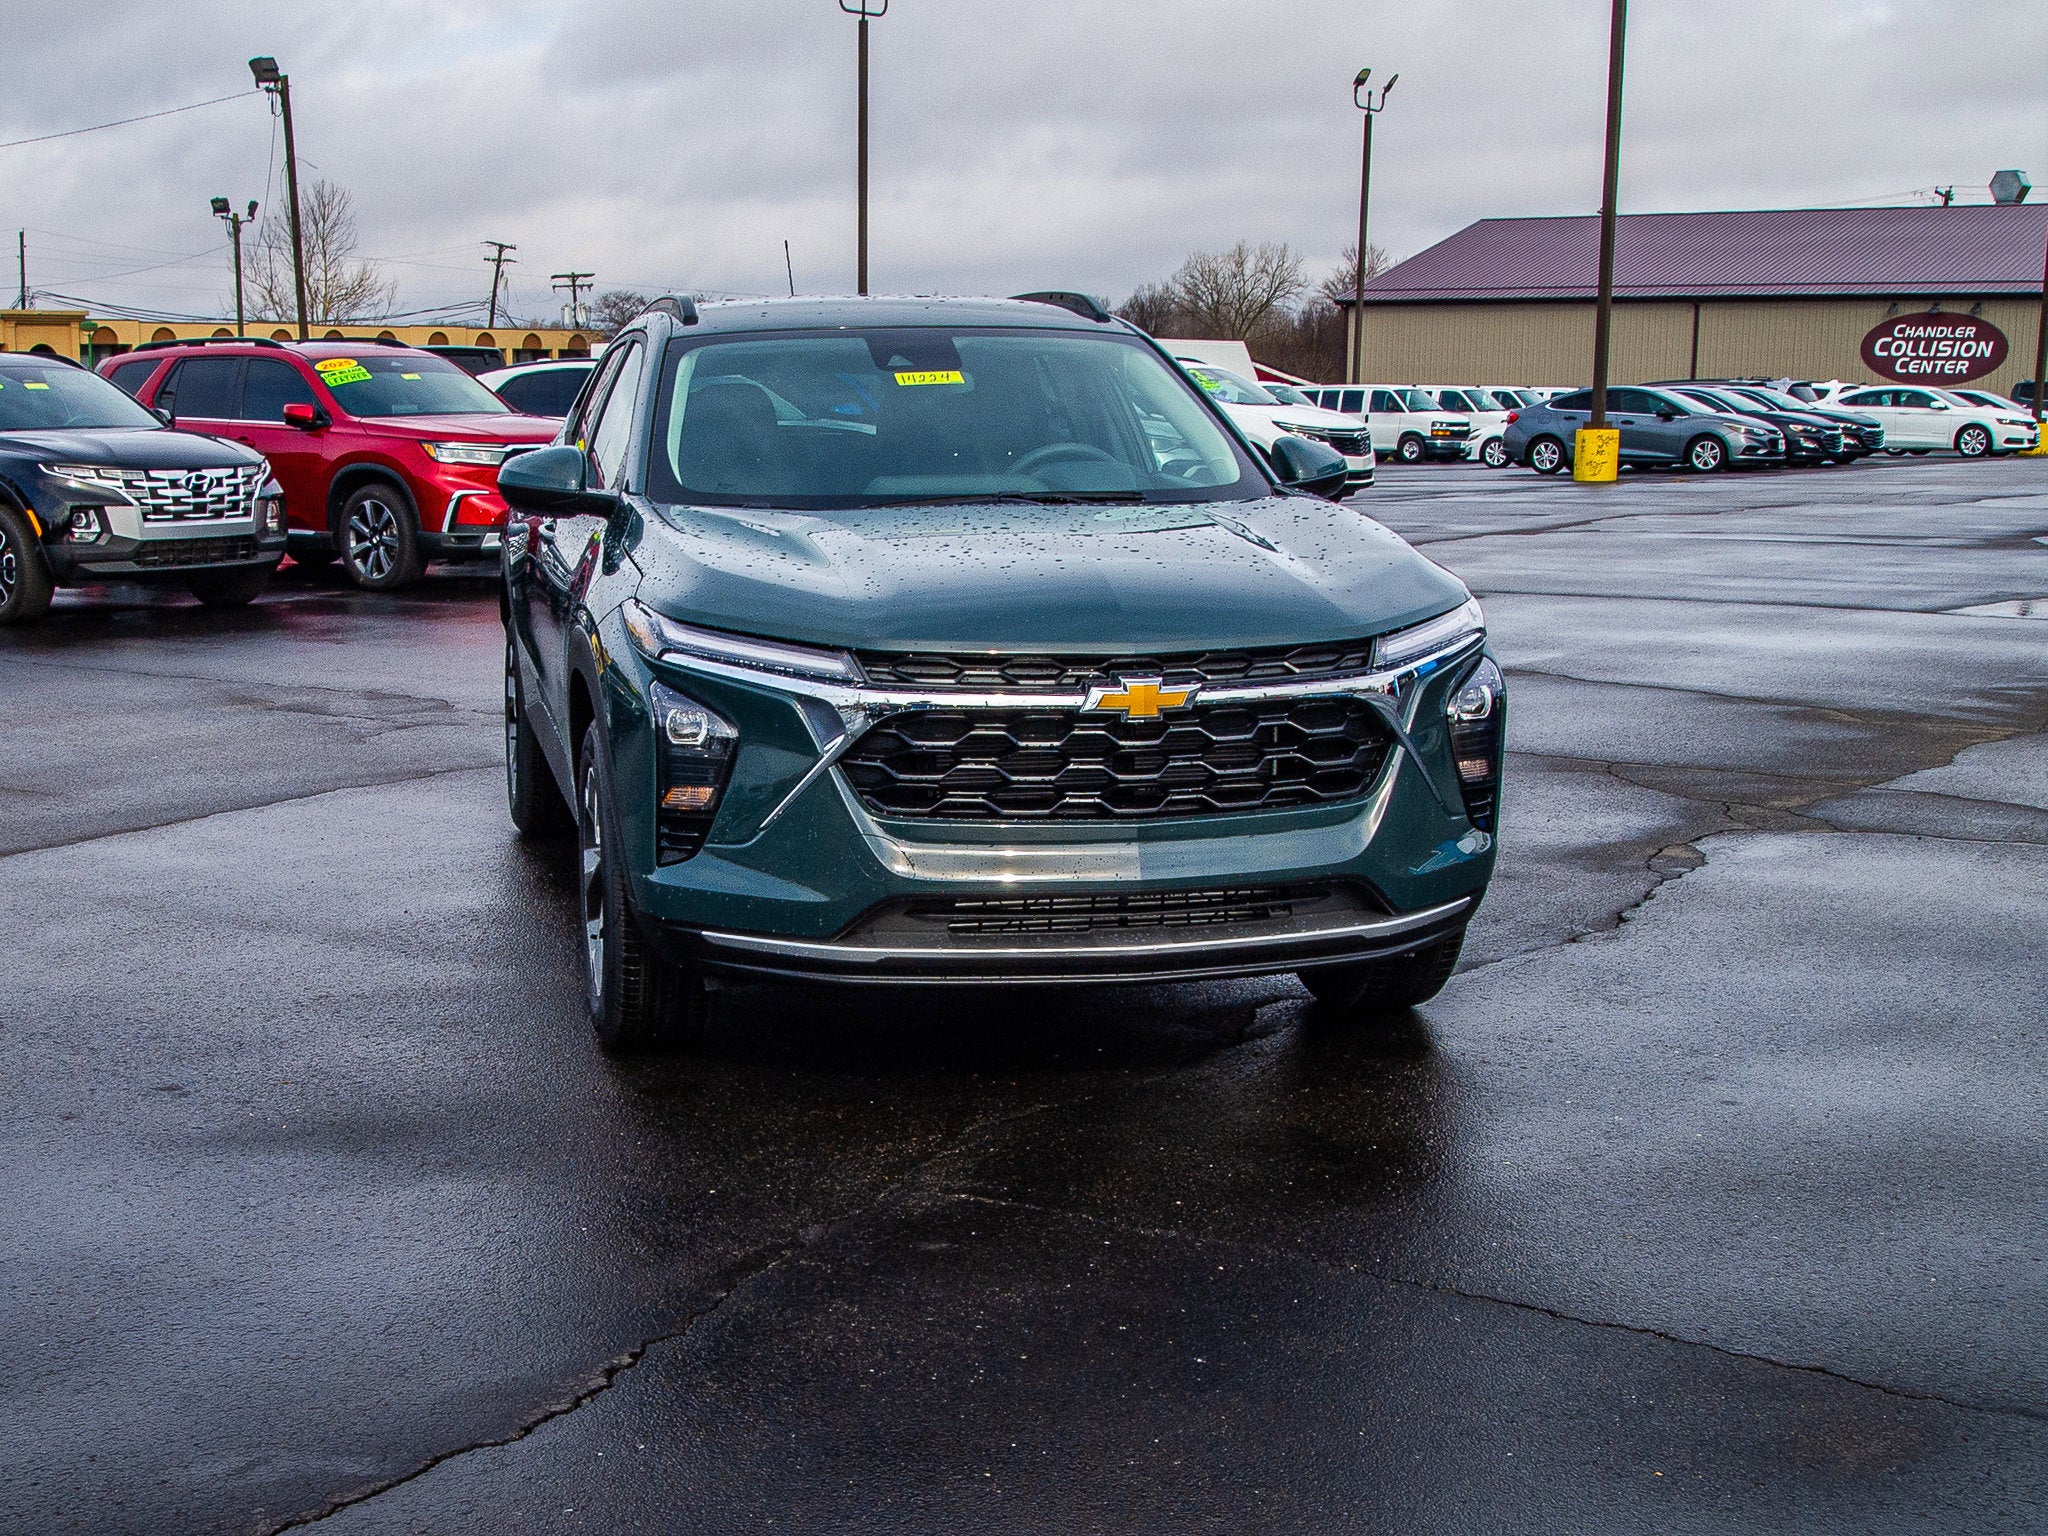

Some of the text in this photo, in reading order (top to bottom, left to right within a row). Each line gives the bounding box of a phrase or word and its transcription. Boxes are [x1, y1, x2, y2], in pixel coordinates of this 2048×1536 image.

[1893, 324, 1976, 338] CHANDLER
[1874, 337, 1994, 358] COLLISION
[321, 360, 352, 370] 2025
[1895, 357, 1969, 374] CENTER
[328, 371, 370, 385] LEATHER
